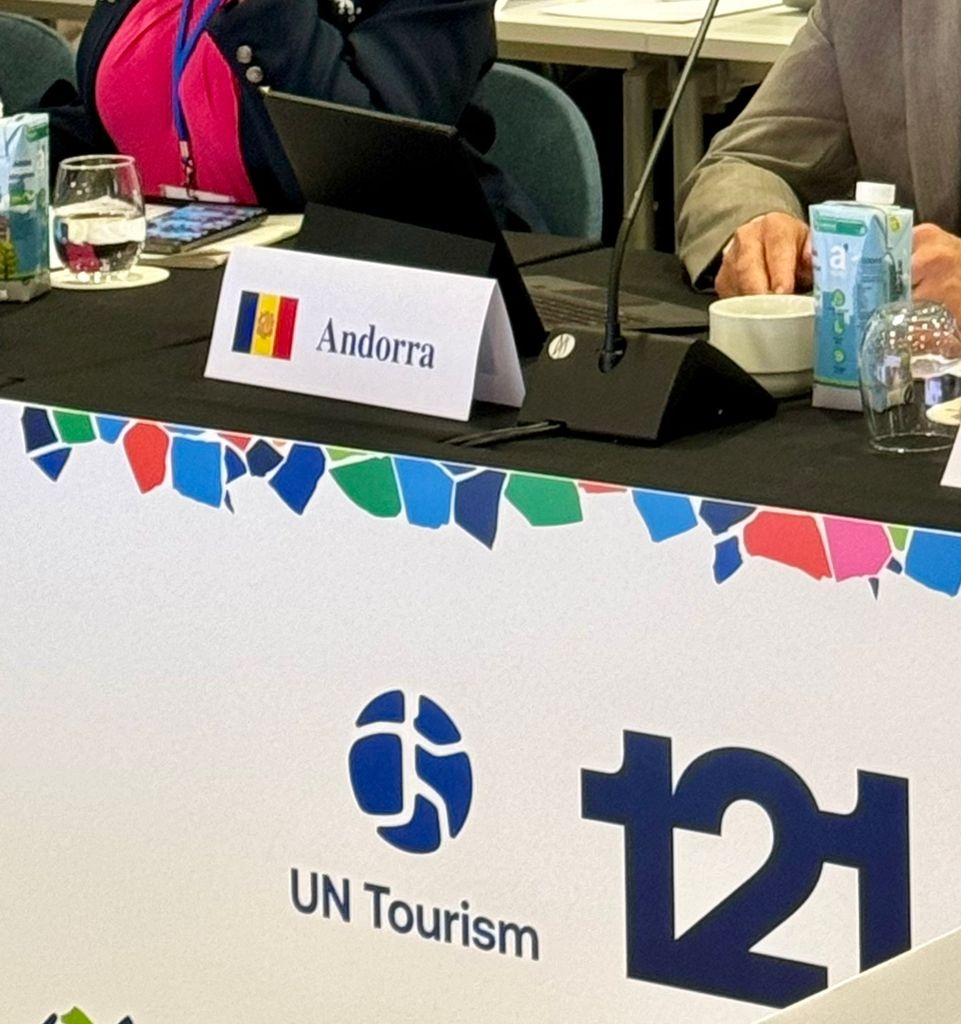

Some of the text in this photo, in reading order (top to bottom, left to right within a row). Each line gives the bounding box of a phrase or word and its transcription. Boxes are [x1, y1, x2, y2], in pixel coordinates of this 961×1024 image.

[316, 317, 435, 369] Andorra
[290, 868, 540, 961] UN Tourism
[580, 729, 912, 1009] 121
